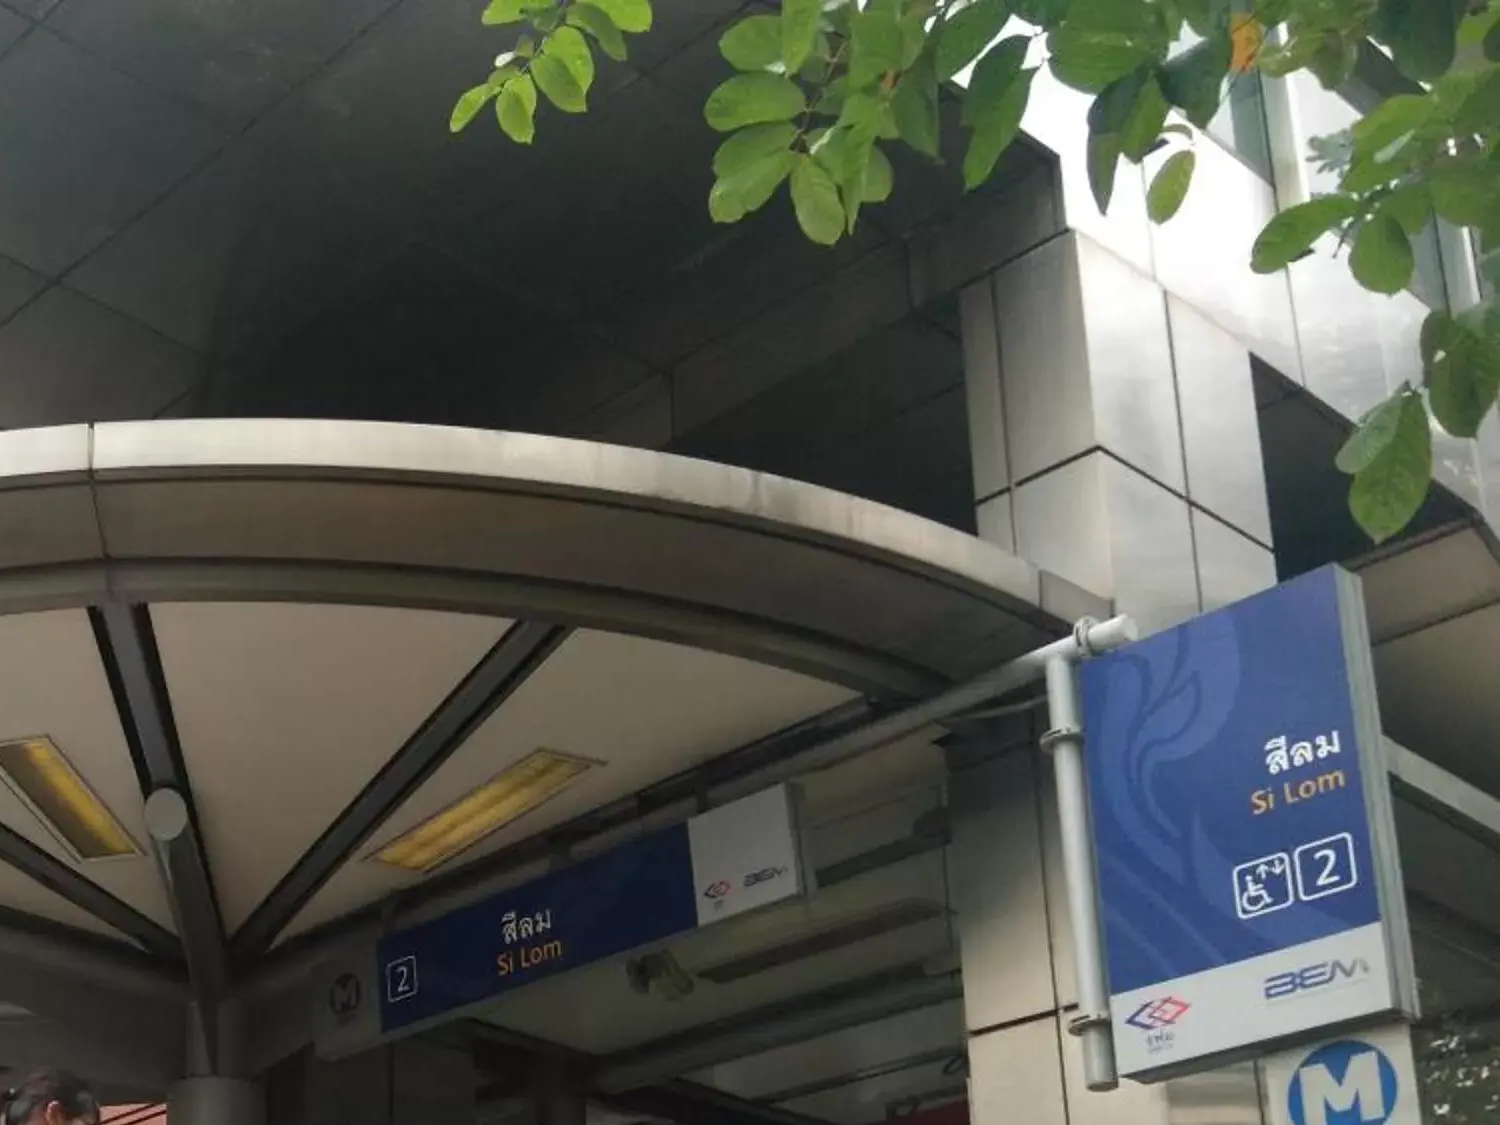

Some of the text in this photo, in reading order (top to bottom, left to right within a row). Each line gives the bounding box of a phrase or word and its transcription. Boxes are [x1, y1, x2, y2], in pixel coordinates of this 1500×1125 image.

[1264, 729, 1341, 775] สีลม
[1251, 769, 1345, 815] Si Lom
[1313, 849, 1341, 886] 2
[501, 909, 551, 944] สีลม
[497, 940, 563, 976] Si Lom
[396, 965, 411, 992] 2
[1263, 956, 1370, 1000] BEM
